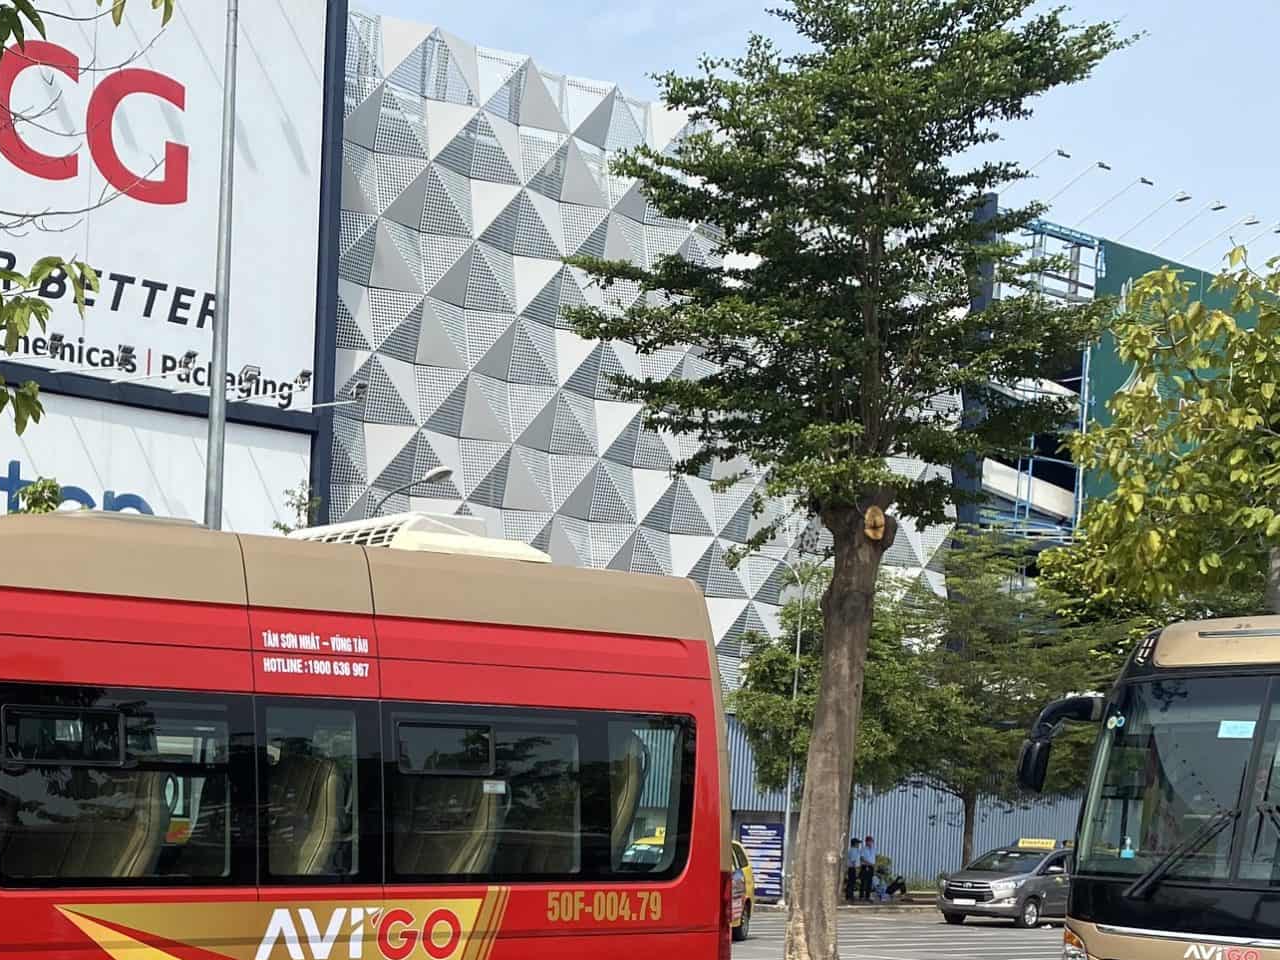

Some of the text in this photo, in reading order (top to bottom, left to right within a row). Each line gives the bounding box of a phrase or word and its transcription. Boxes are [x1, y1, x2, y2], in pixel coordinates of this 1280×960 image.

[263, 657, 302, 673] HOTLINE
[352, 661, 369, 677] 967
[547, 891, 662, 921] 50F-004.79
